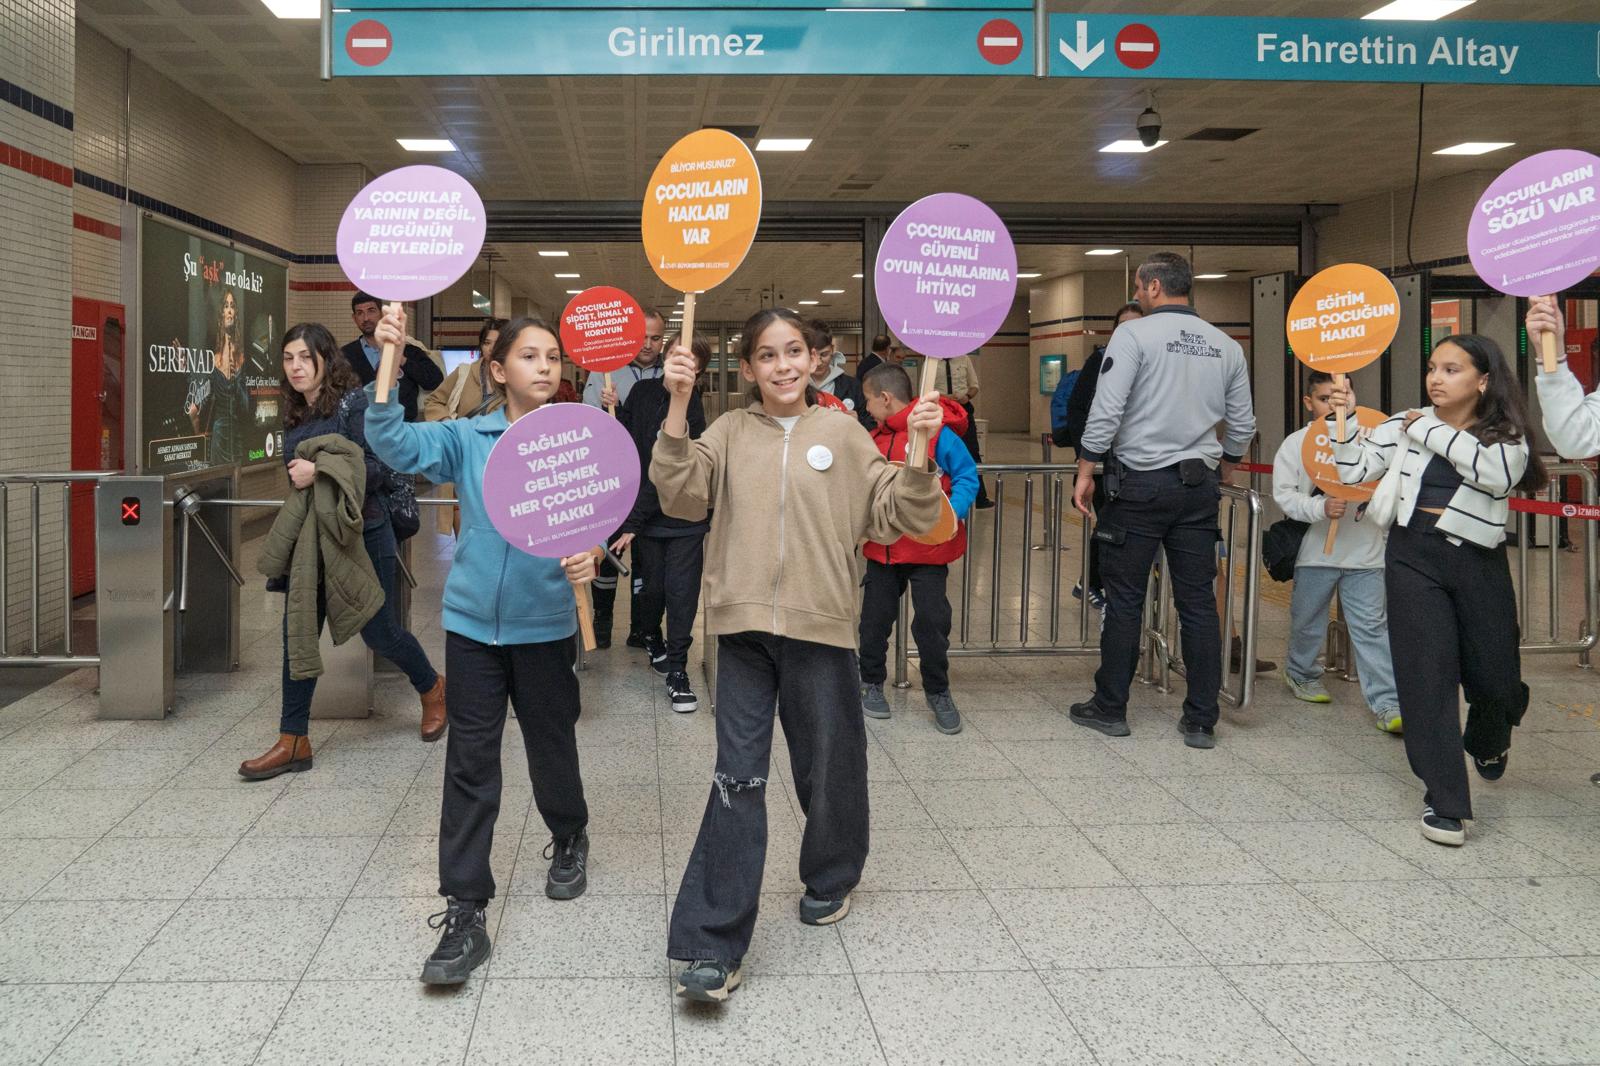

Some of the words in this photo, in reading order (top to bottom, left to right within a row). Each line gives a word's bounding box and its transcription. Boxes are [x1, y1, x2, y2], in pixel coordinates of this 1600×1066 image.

[608, 27, 765, 57] Girilmez
[1257, 33, 1416, 65] Fahrettin
[1427, 36, 1519, 74] Altay
[696, 158, 736, 170] MUSUNUZ?
[369, 191, 461, 206] ÇOCUKLAR
[655, 178, 748, 204] ÇOCUKLARIN
[1482, 164, 1594, 215] ÇOCUKLARIN
[353, 207, 419, 220] YARININ
[423, 204, 476, 222] DEĞİL,
[668, 203, 730, 222] HAKLARI
[1488, 198, 1544, 234] SÖZÜ
[1548, 186, 1596, 213] VAR
[369, 221, 453, 238] BUGÜNÜN
[682, 228, 710, 245] VAR
[906, 222, 996, 243] ÇOCUKLARIN
[353, 238, 464, 255] BİREYLERİDİR
[920, 241, 979, 260] GÜVENLİ
[184, 252, 198, 281] Şu
[225, 271, 237, 286] ne
[237, 270, 251, 291] ola
[251, 271, 263, 293] ki?
[883, 258, 923, 275] OYUN
[925, 262, 1010, 281] ALANLARINA
[916, 276, 976, 297] İHTİYACI
[576, 300, 622, 314] ÇOCUKLARI
[933, 300, 960, 315] VAR
[1316, 290, 1365, 311] EĞİTİM
[597, 308, 622, 319] İHMAL
[623, 306, 634, 315] VE
[1290, 316, 1317, 332] HER
[1319, 303, 1395, 329] ÇOCUĞUN
[575, 316, 629, 331] İSTİSMARDAN
[584, 326, 623, 338] KORUYUN
[1320, 324, 1366, 342] HAKKI
[149, 344, 215, 374] SERENAD
[517, 426, 592, 456] SAĞLIKLA
[527, 446, 590, 473] YAŞAYIP
[524, 462, 600, 494] GELİŞMEK
[509, 499, 541, 517] HER
[542, 476, 620, 510] ÇOCUĞUN
[547, 503, 595, 527] HAKKI
